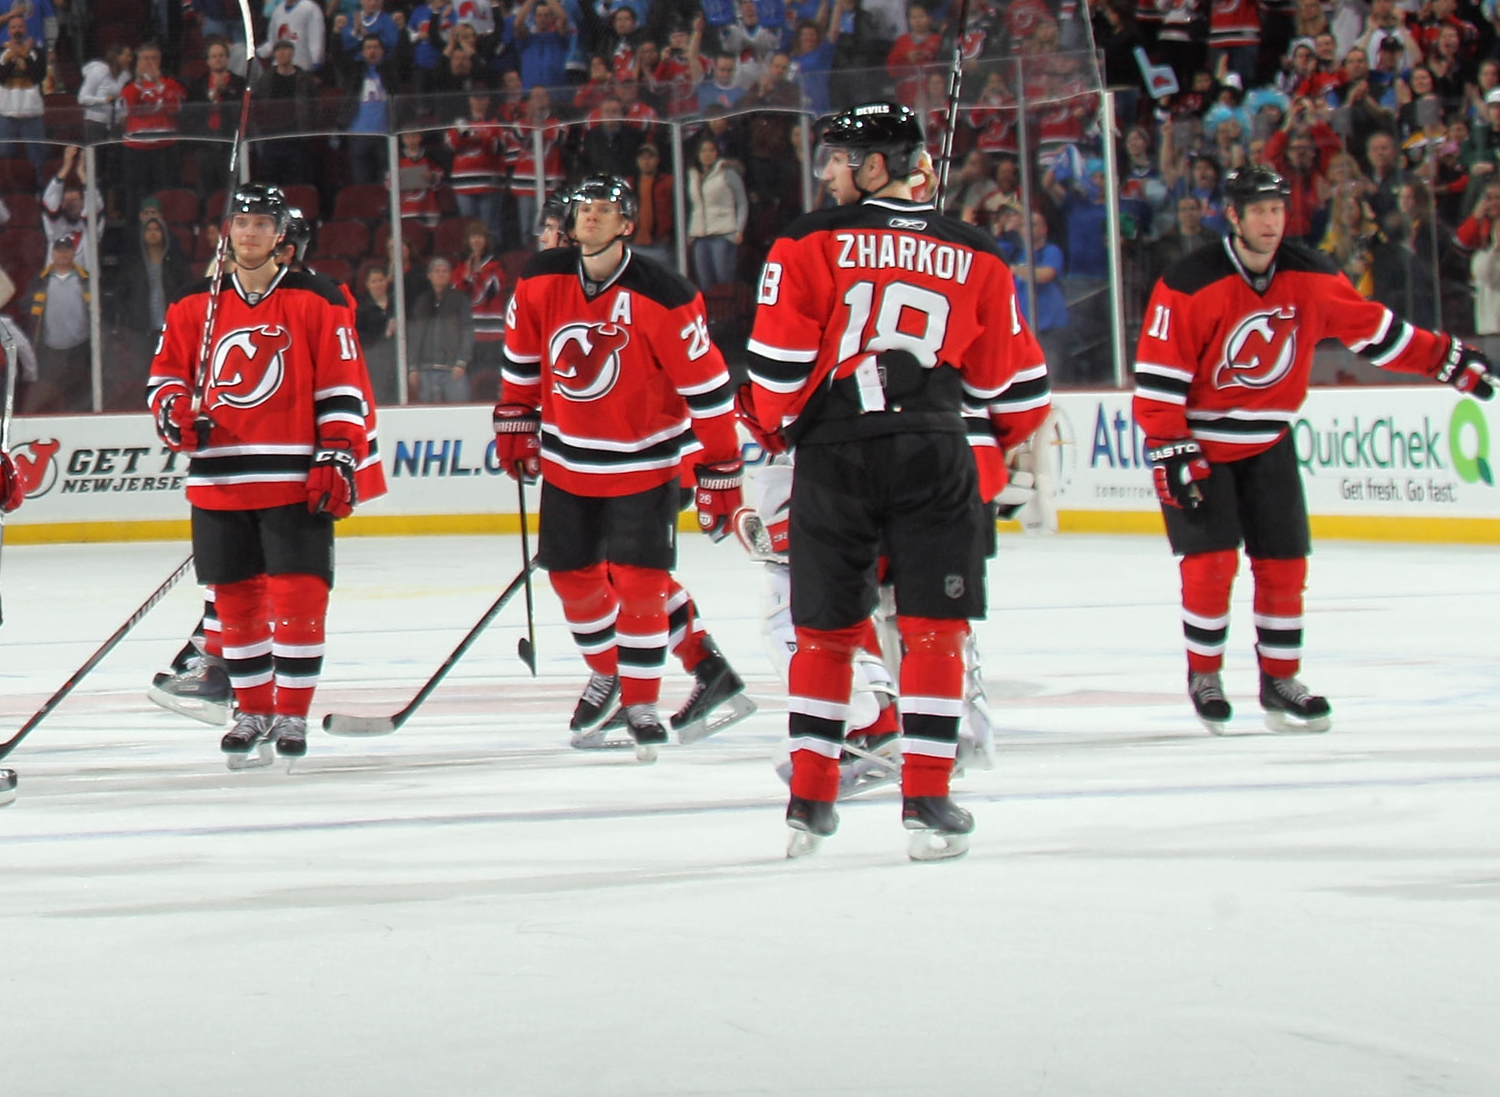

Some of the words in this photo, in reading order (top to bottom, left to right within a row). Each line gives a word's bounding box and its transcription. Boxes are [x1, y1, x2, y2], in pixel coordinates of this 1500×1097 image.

[855, 105, 890, 116] DEVILS
[836, 234, 974, 285] ZHARKOV
[610, 291, 633, 325] A
[837, 281, 951, 369] 18
[1147, 305, 1171, 341] 11
[66, 447, 151, 476] GET
[1295, 416, 1444, 476] QuickChek
[699, 493, 712, 505] 26
[1342, 478, 1364, 501] Get
[1367, 477, 1402, 501] fresh.
[1407, 480, 1425, 503] Go
